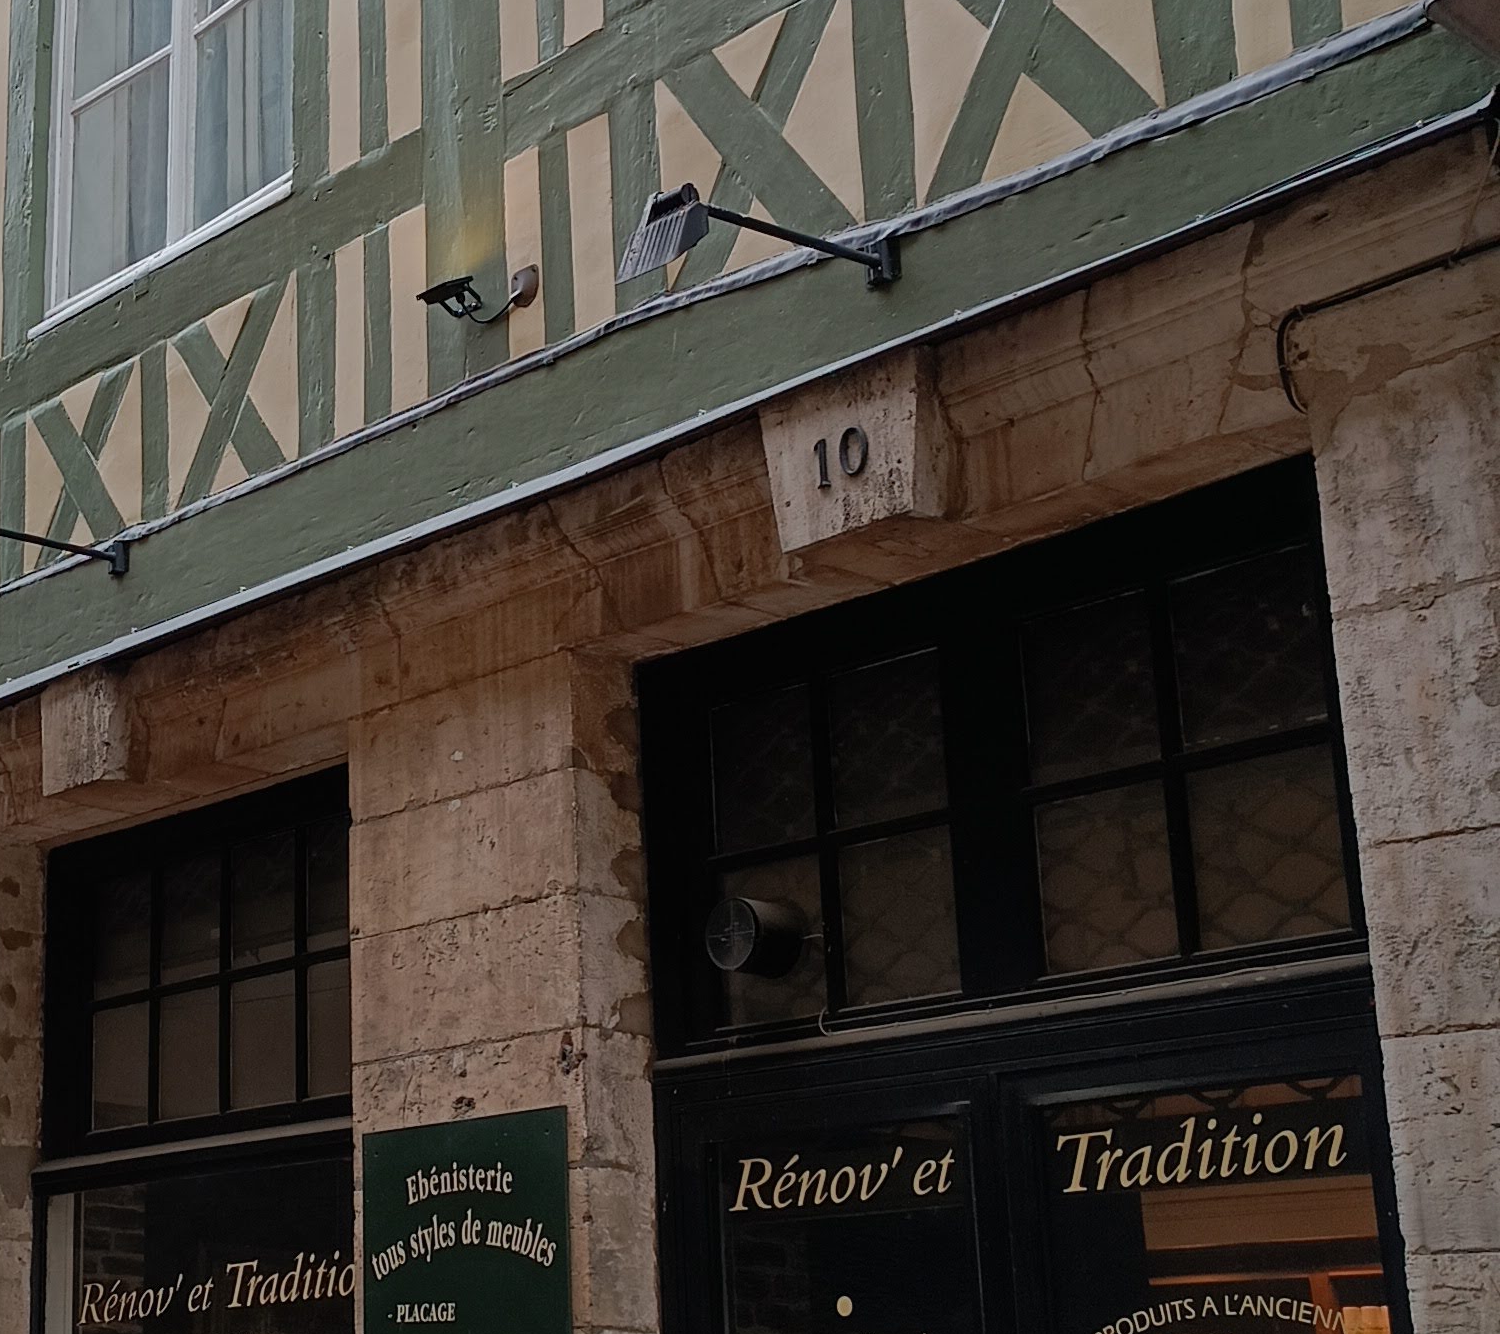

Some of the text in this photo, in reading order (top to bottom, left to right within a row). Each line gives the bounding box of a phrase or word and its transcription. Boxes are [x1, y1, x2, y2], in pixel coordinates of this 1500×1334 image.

[813, 426, 869, 490] 10
[728, 1146, 955, 1212] Rénov' et
[1056, 1112, 1348, 1193] Tradition
[406, 1162, 513, 1206] Ebénisterie
[371, 1208, 557, 1281] tous styles de meubles
[77, 1273, 183, 1327] Rénov'
[188, 1277, 213, 1312] et
[396, 1303, 456, 1323] PLACAGE
[1202, 1296, 1218, 1317] A
